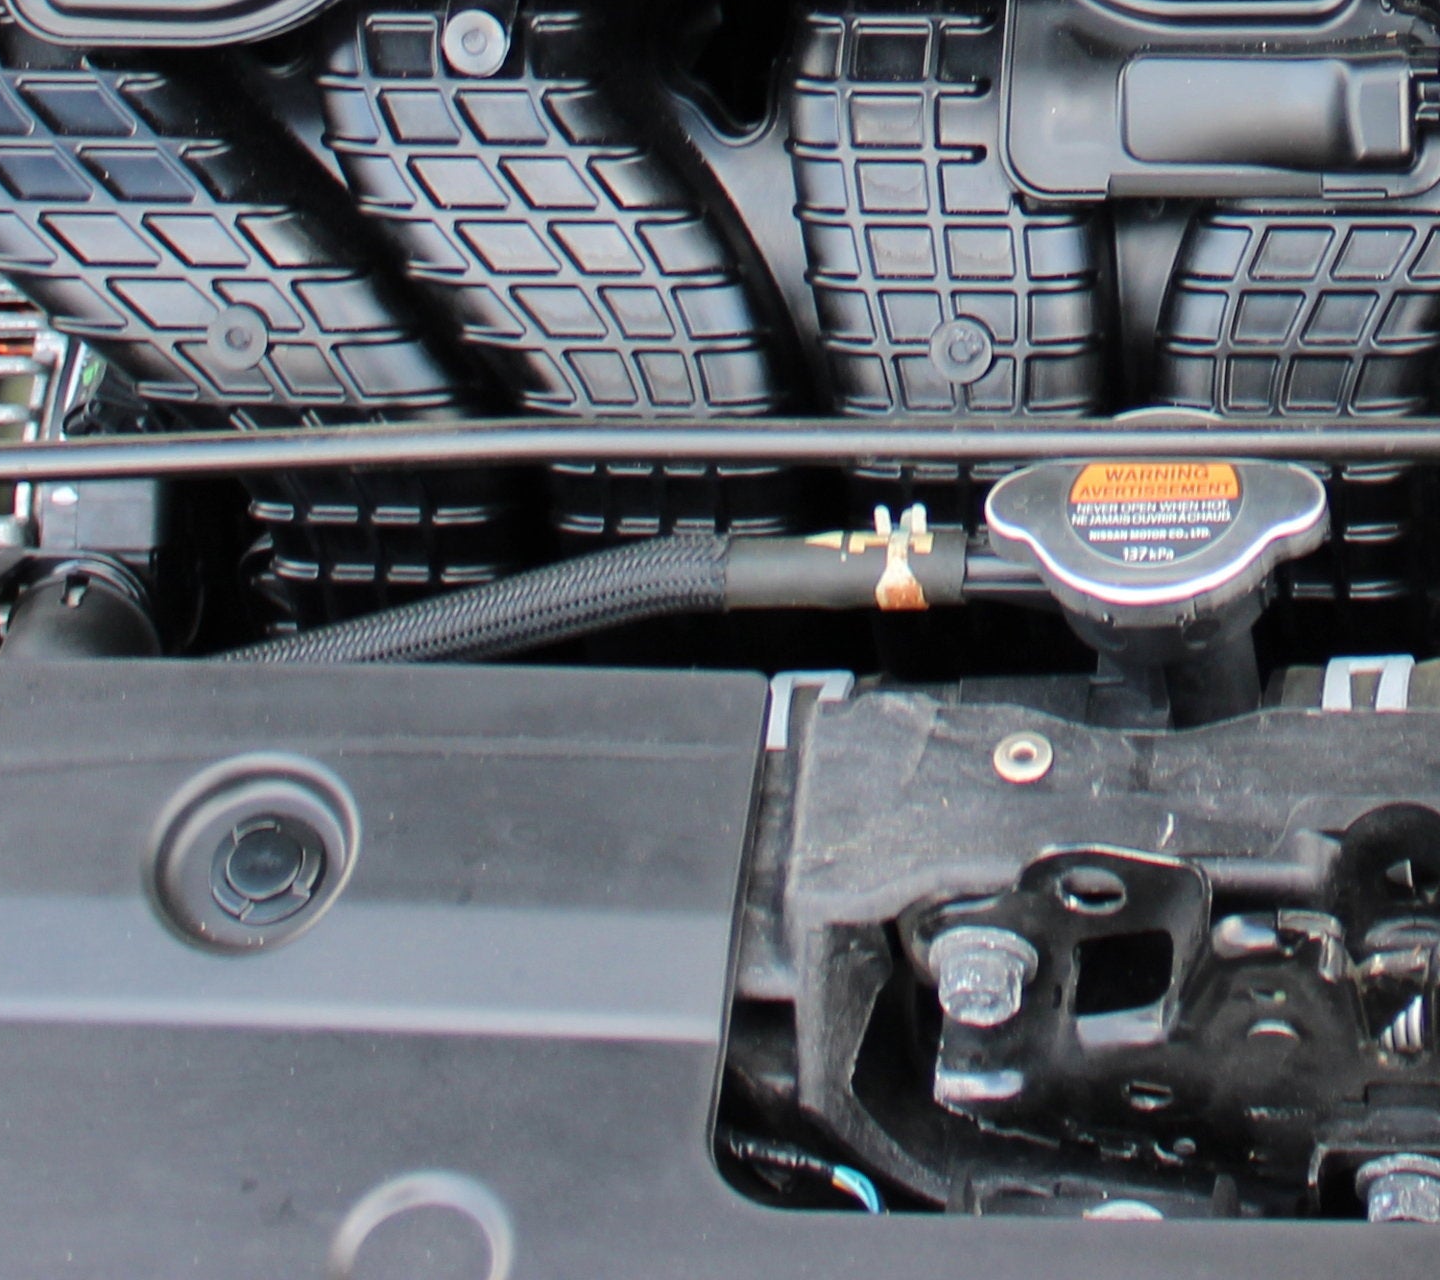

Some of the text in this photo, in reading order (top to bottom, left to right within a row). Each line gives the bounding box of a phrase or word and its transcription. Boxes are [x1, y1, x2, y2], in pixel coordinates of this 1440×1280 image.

[1105, 464, 1208, 483] WARNING
[1079, 483, 1233, 500] AVERTISSEMENT
[1076, 502, 1118, 515] NEVER
[1120, 502, 1157, 514] OPEN
[1160, 500, 1199, 513] WHEN
[1089, 529, 1128, 541] NISSAN
[1129, 528, 1167, 541] MOTOR
